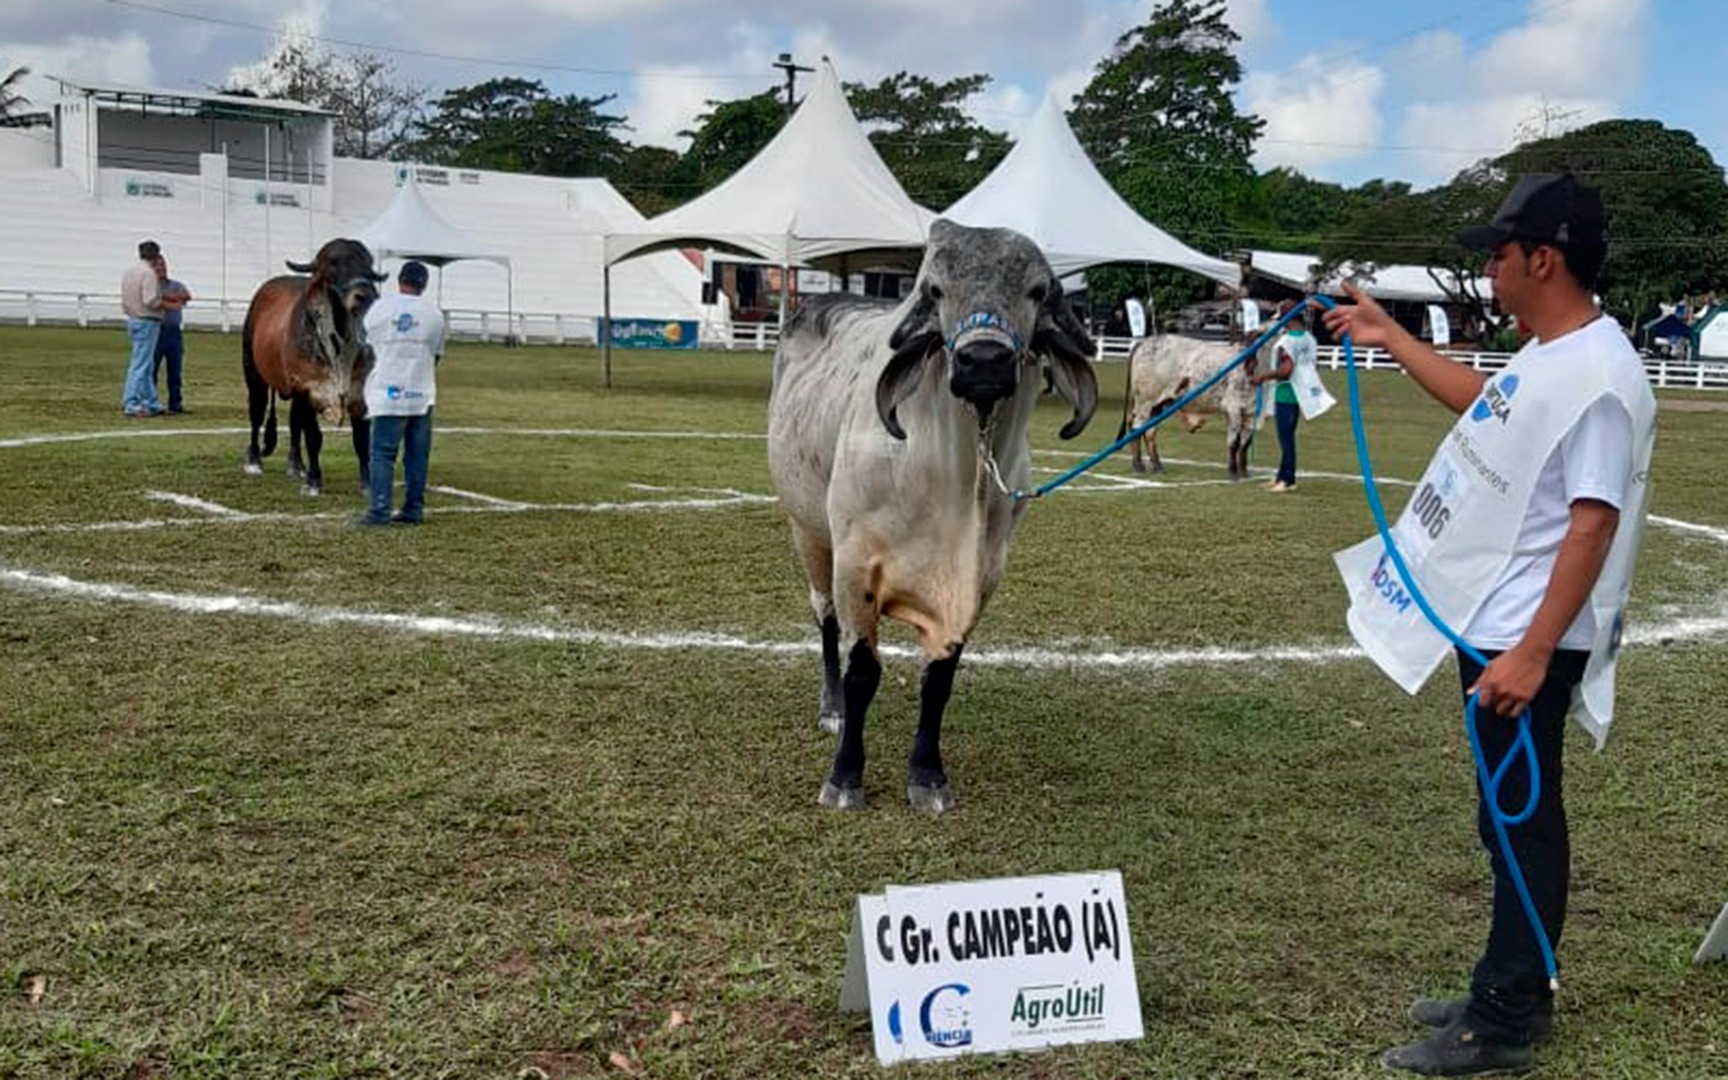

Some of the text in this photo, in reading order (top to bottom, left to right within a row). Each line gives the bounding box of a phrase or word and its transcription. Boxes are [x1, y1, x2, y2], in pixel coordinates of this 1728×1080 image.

[1413, 483, 1450, 540] 006
[1375, 569, 1411, 613] DSM
[901, 914, 940, 966] Gr.
[1011, 980, 1104, 1028] AgroÚtil
